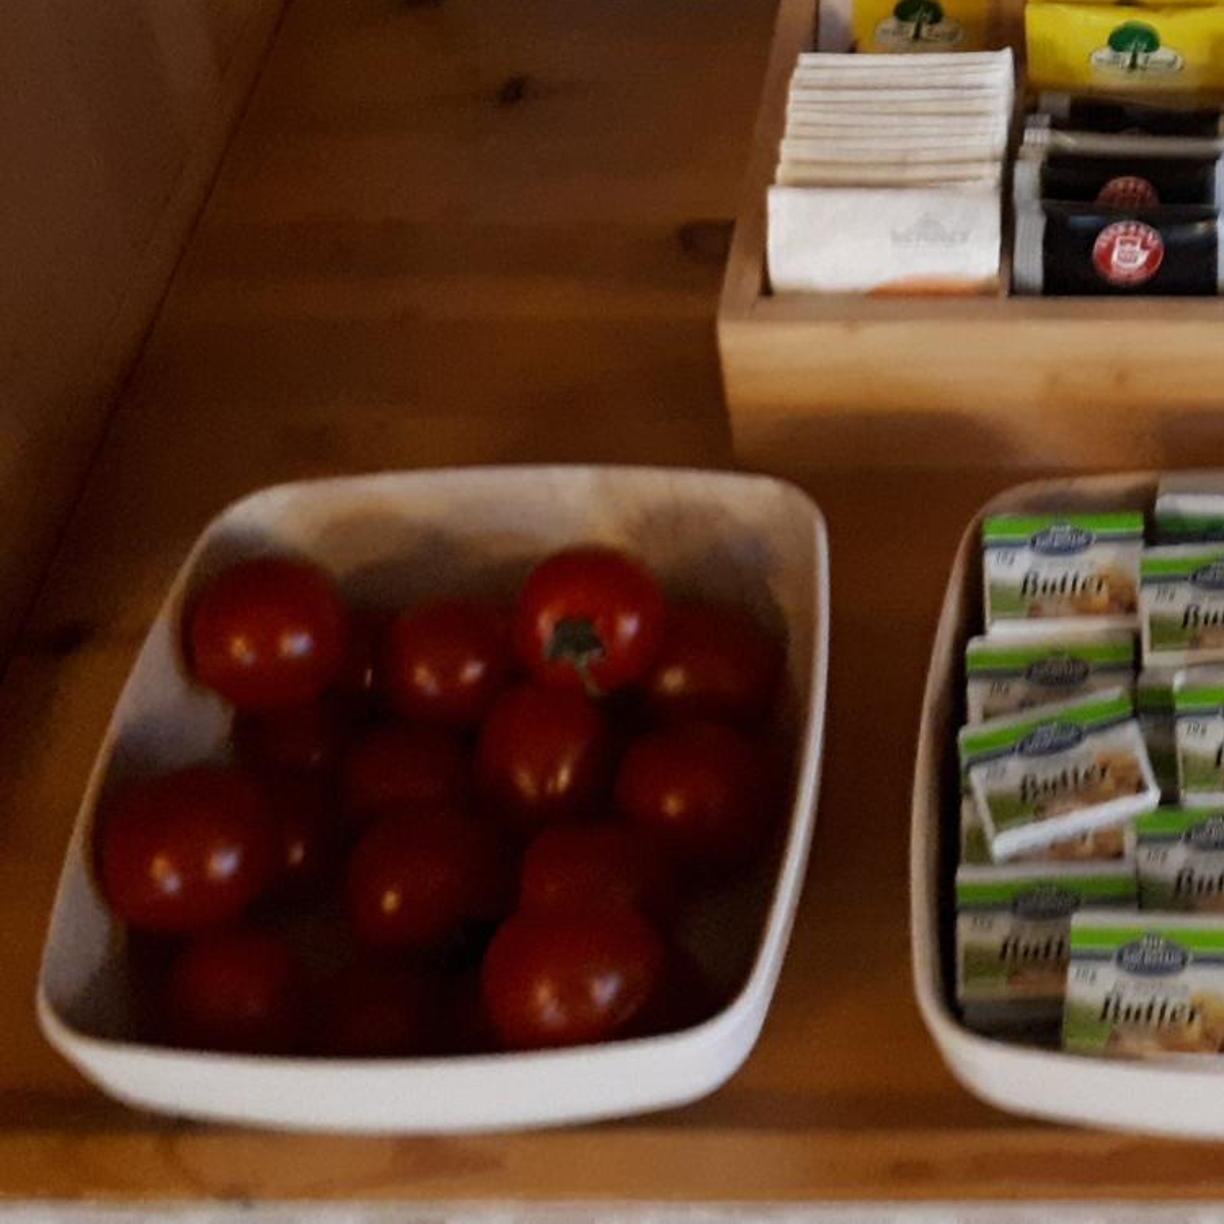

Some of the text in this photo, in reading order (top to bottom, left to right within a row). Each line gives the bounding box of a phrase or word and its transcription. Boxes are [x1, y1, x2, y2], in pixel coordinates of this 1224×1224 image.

[1020, 571, 1109, 600] Butter
[1020, 763, 1111, 804] Butter
[999, 934, 1067, 963] Butt
[1100, 993, 1203, 1026] Butter
